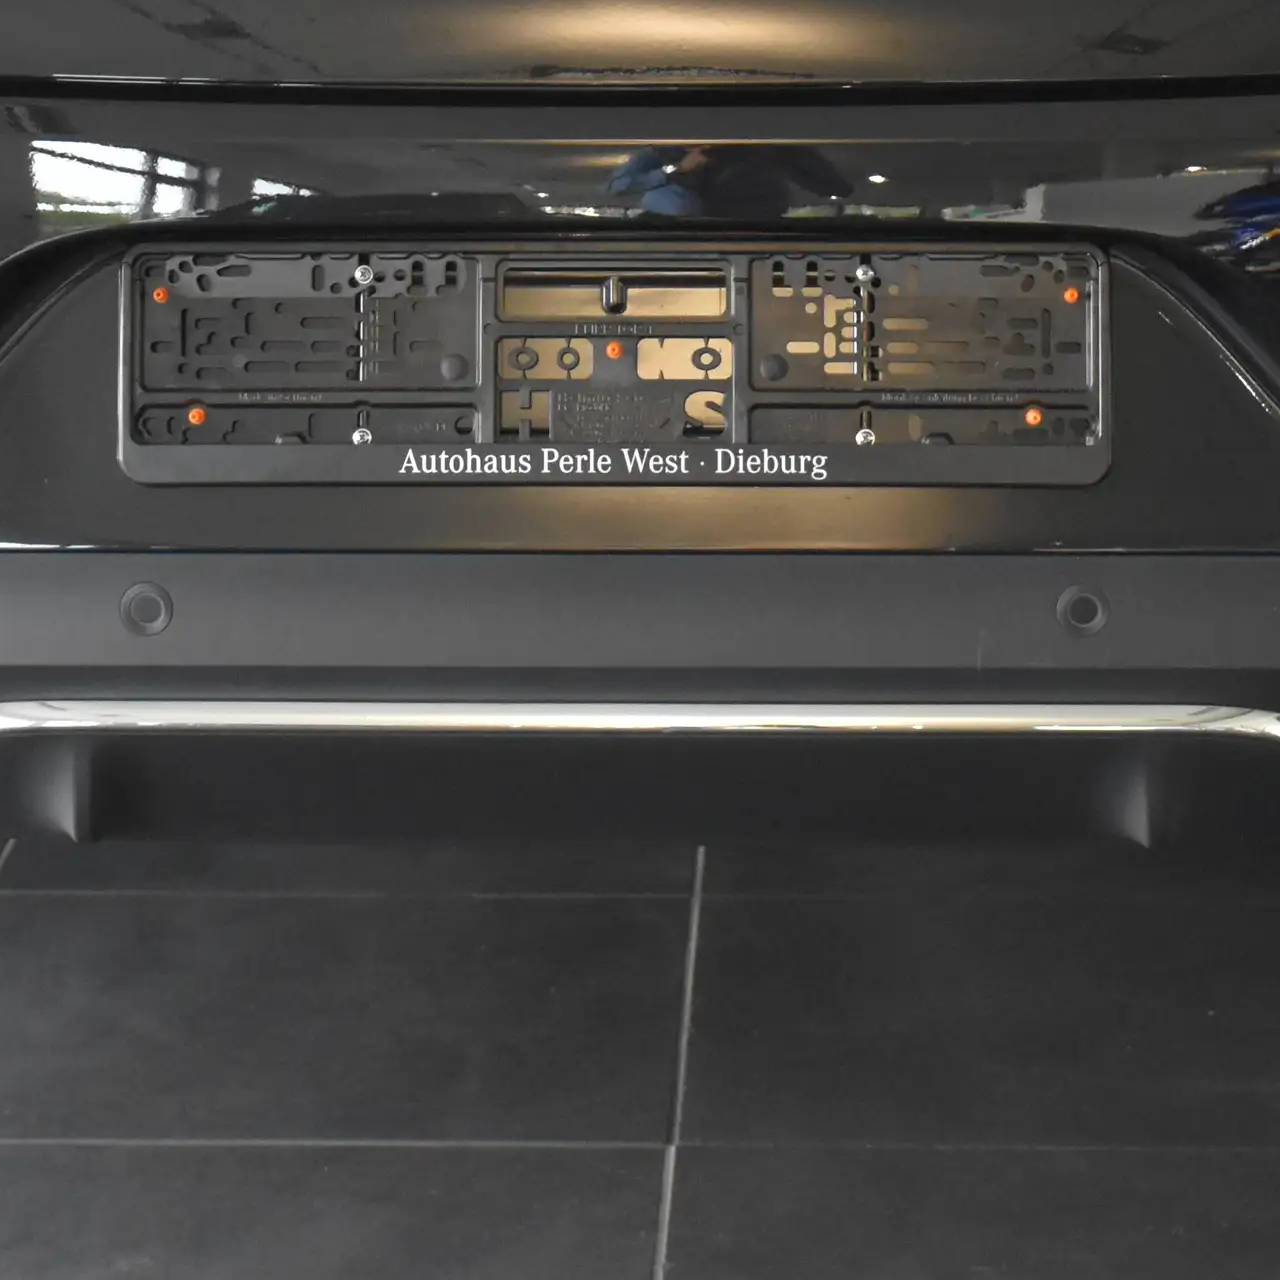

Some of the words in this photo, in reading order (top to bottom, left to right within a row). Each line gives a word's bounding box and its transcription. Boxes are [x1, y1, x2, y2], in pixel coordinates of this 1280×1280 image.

[399, 447, 532, 474] Autohaus
[540, 447, 612, 474] Perle
[620, 447, 690, 474] West
[714, 447, 829, 481] Dieburg
